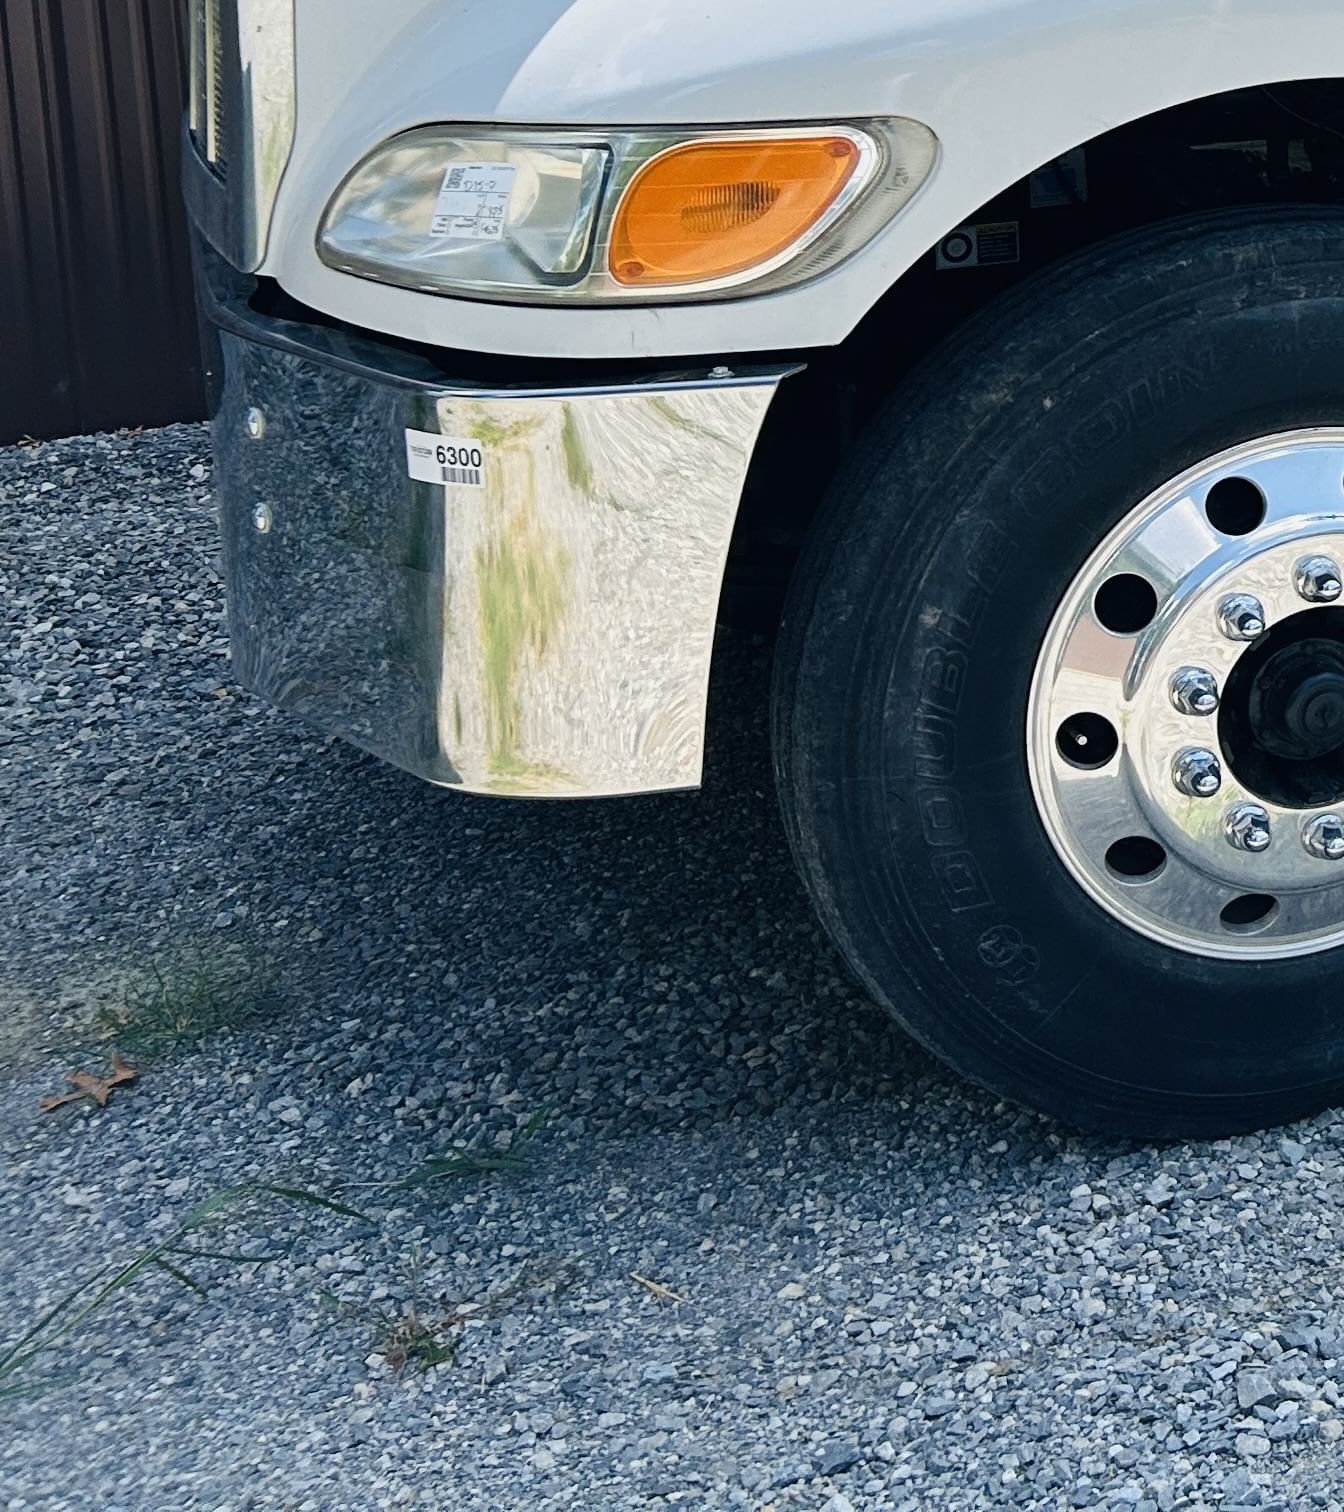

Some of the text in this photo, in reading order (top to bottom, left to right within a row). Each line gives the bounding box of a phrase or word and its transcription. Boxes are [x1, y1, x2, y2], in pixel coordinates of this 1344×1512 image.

[436, 444, 482, 468] 6300
[911, 343, 1217, 913] DOUBLE COIN
